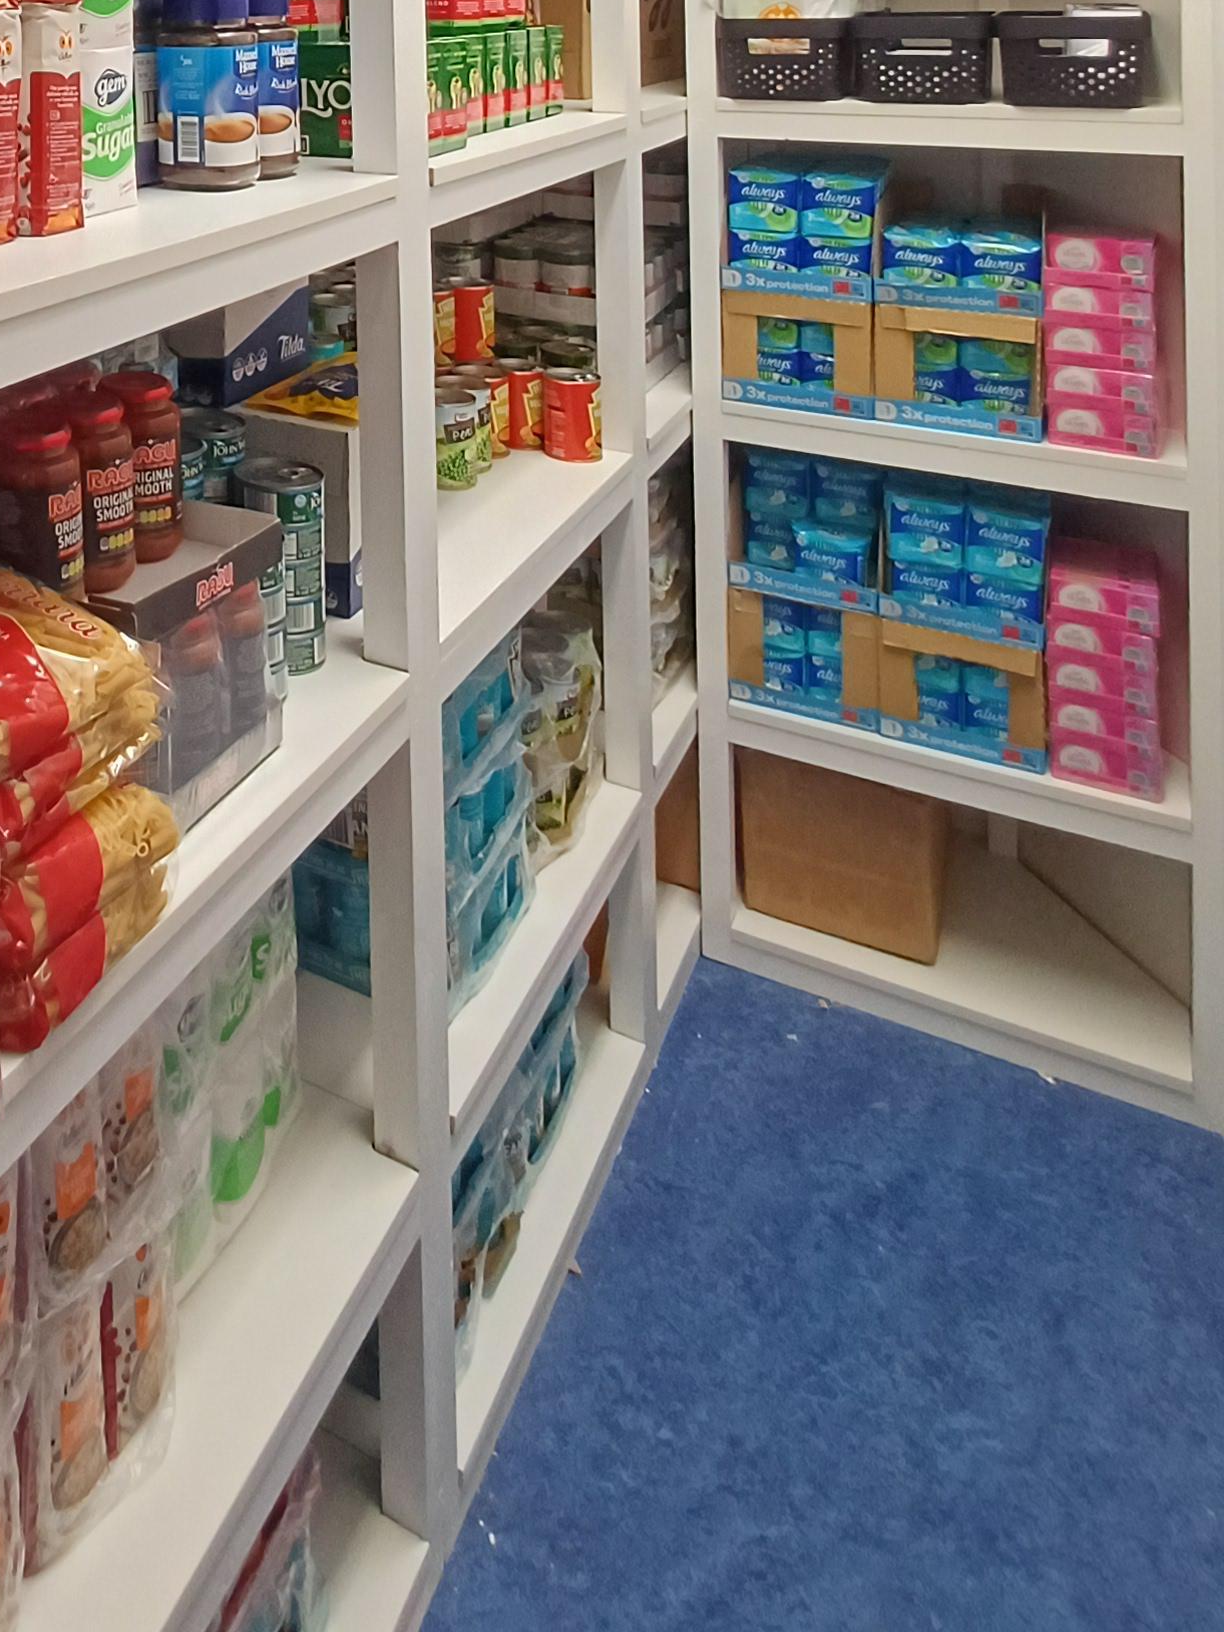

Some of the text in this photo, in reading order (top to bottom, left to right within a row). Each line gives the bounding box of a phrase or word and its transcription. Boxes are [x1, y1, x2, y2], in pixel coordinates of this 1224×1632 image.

[97, 74, 127, 107] gem
[741, 183, 786, 201] always
[815, 189, 863, 208] always
[742, 239, 787, 258] always
[813, 246, 860, 265] always
[894, 247, 945, 267] always
[974, 255, 1026, 274] always
[745, 275, 766, 289] 3x
[766, 279, 829, 295] protection
[902, 288, 994, 308] 3x protection
[278, 333, 306, 360] Tilda
[746, 386, 767, 400] 3x
[767, 390, 829, 408] protection
[973, 380, 1025, 398] always
[902, 407, 994, 431] 3x protection
[213, 441, 238, 458] JOHN
[93, 488, 135, 510] ORIGINA
[900, 512, 952, 533] always
[978, 526, 1032, 549] always
[800, 549, 848, 569] always
[196, 563, 235, 608] RAGU
[752, 571, 774, 587] 3x
[899, 570, 950, 591] always
[976, 585, 1029, 609] always
[755, 689, 776, 703] 3x
[907, 726, 929, 740] 3x
